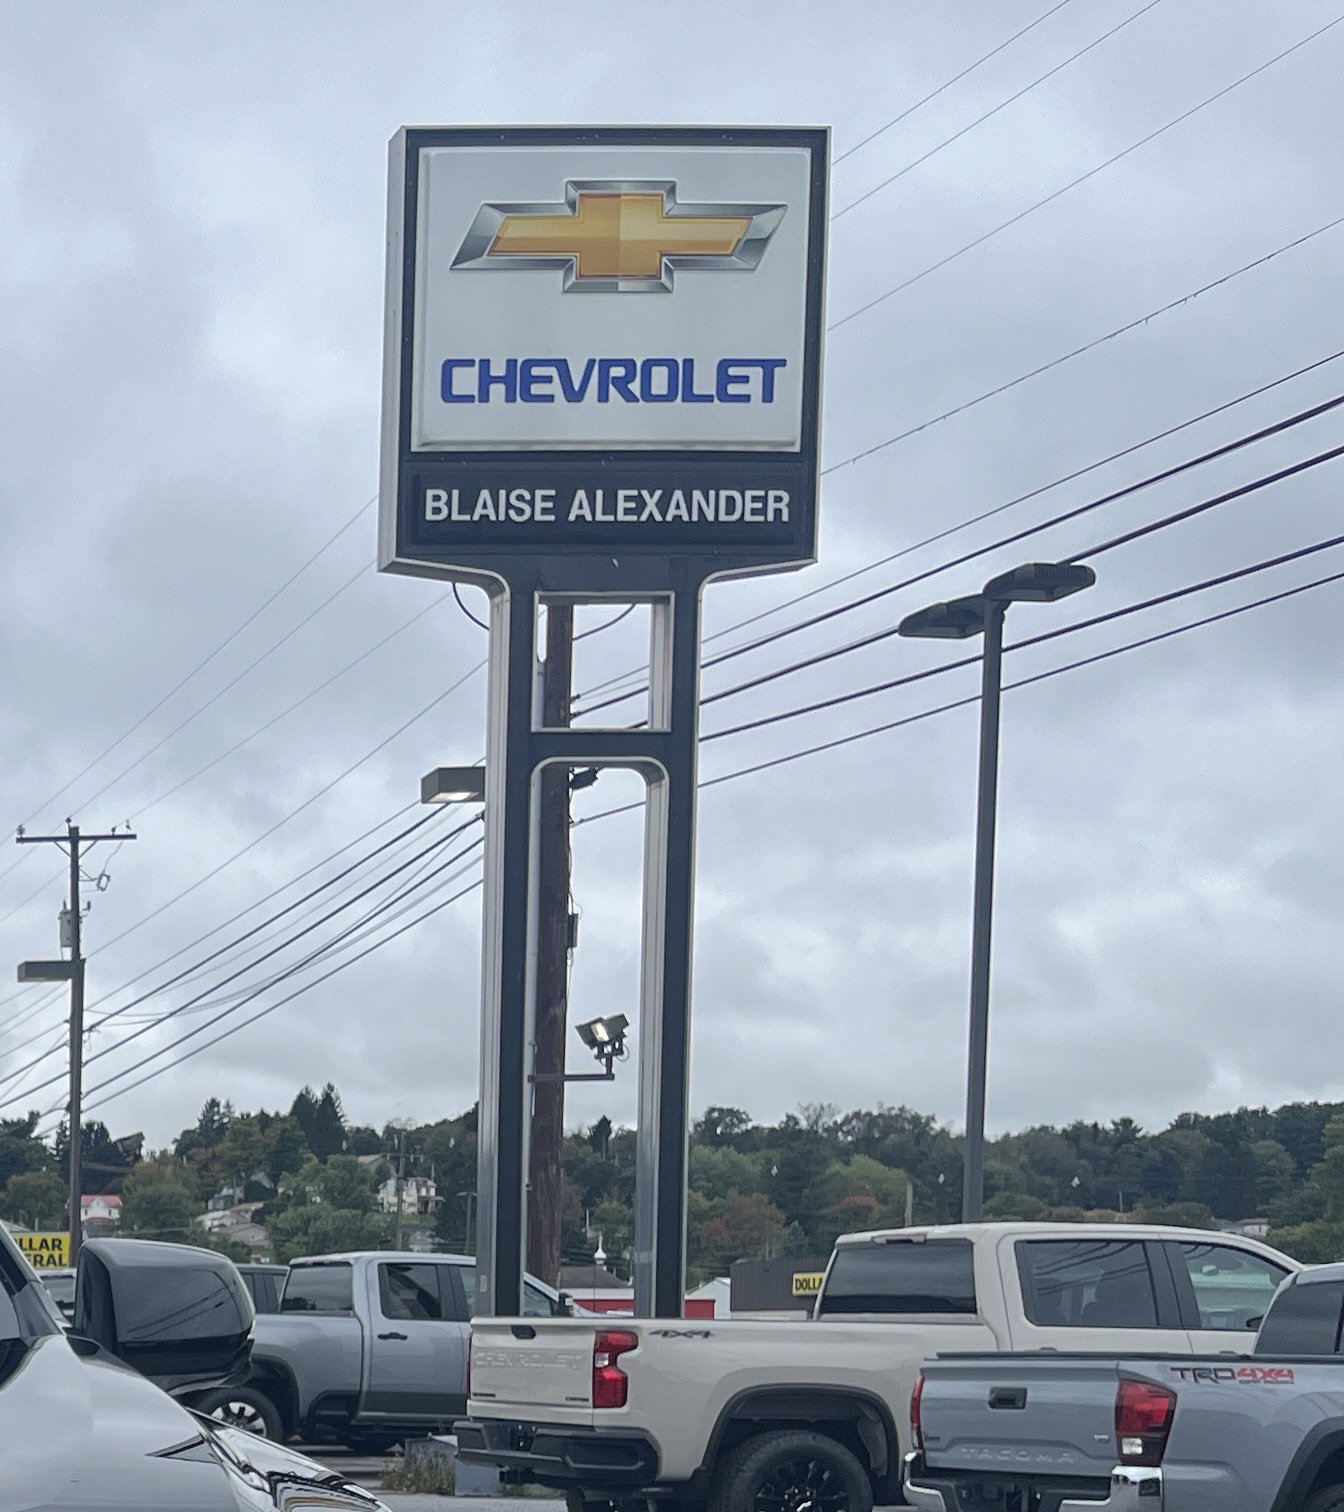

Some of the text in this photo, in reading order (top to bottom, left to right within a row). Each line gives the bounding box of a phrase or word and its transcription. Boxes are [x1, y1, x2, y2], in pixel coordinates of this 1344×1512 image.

[440, 357, 788, 404] CHEVROLET
[424, 488, 790, 523] BLAISE ALEXANDER
[13, 1237, 63, 1252] LLAR
[1170, 1367, 1236, 1385] TRD
[960, 1448, 1075, 1465] TACOMA
